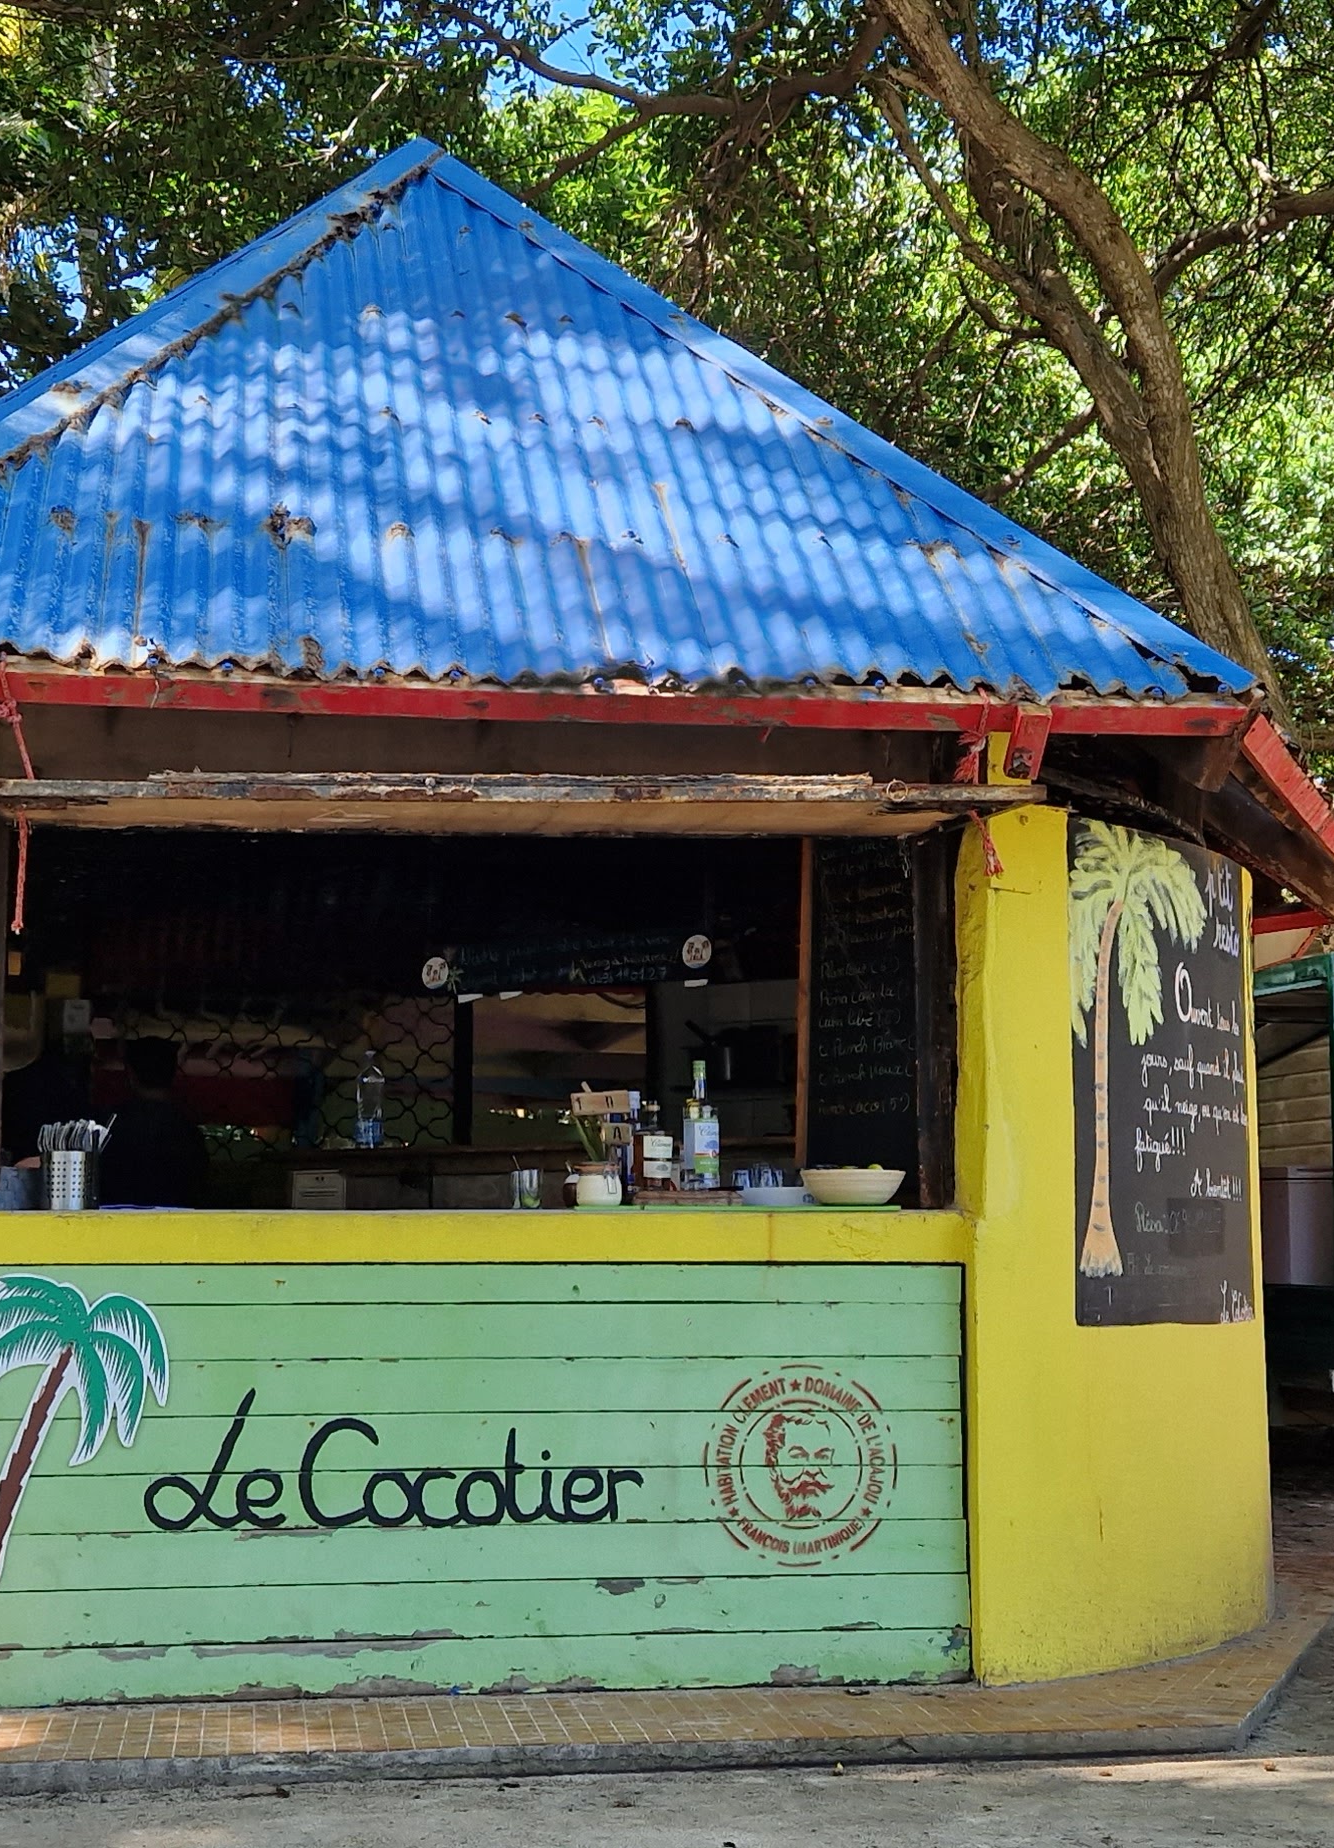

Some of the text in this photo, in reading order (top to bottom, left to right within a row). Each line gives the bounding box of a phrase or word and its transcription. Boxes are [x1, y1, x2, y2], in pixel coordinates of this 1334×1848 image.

[1212, 916, 1240, 958] resto
[1175, 961, 1214, 1030] Ouvert
[1173, 1044, 1195, 1090] sauf
[1196, 1056, 1222, 1090] quand
[144, 1387, 645, 1531] Le Cocotier
[716, 1378, 787, 1506] HABITATION CLEMENT
[804, 1376, 886, 1505] DOMAINE DE L'ACAJOU
[737, 1516, 867, 1555] FRANCOIS (MARTINIQUE)
